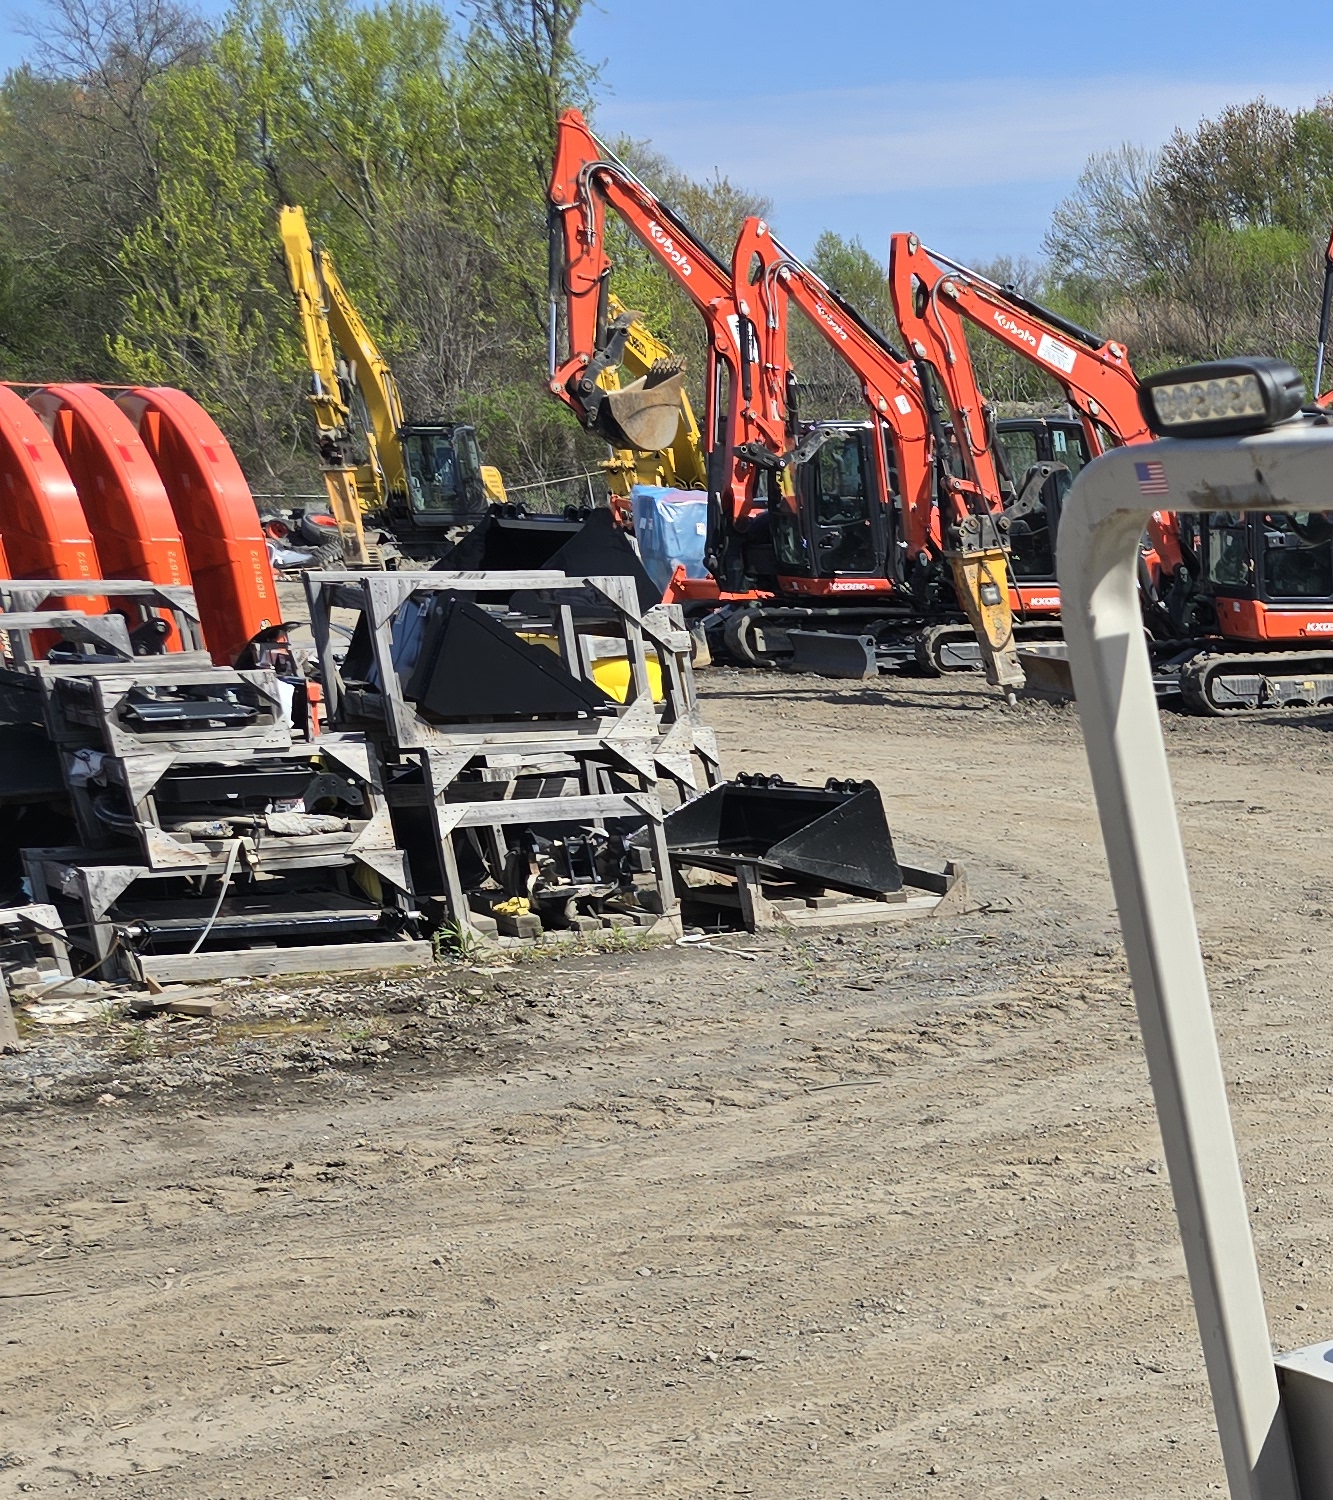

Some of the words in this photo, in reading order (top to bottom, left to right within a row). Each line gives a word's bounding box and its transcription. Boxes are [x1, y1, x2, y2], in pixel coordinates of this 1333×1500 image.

[647, 220, 692, 277] Kubota
[815, 302, 848, 341] Kubota
[993, 310, 1037, 347] Kubota
